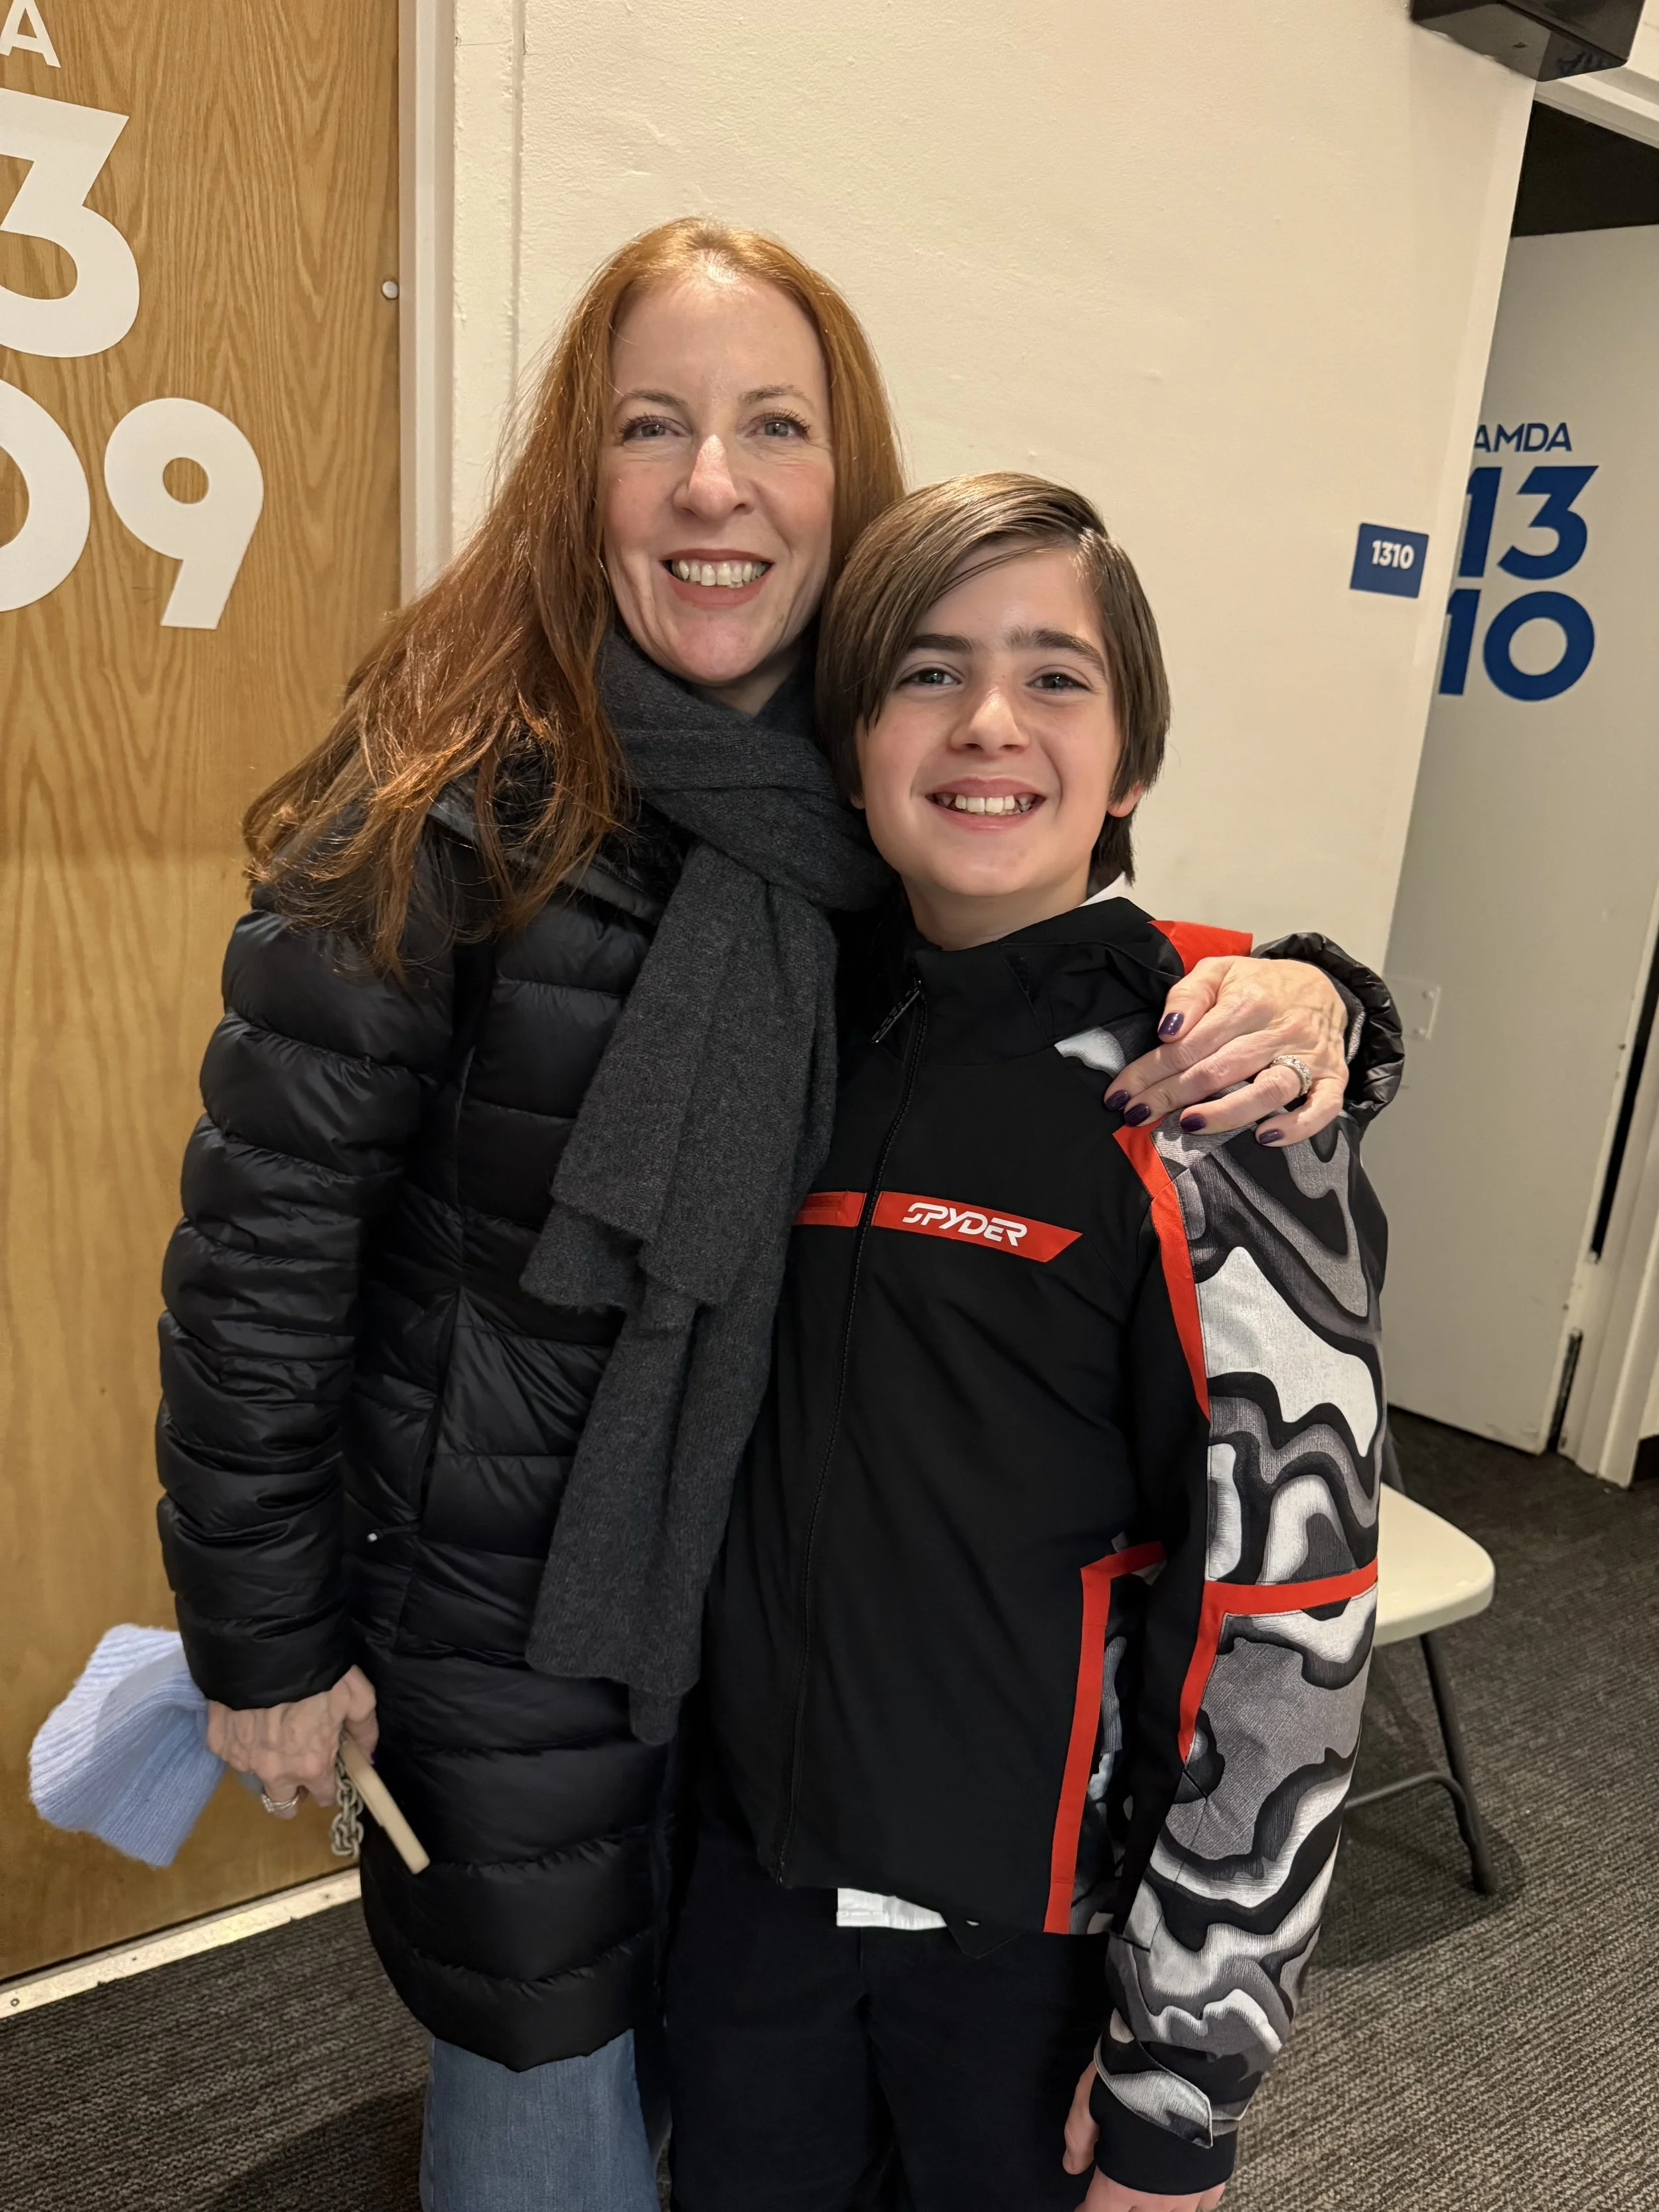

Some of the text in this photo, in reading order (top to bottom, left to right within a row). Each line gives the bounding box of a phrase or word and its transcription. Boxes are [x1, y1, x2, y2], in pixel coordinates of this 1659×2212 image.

[1473, 422, 1573, 453] AMDA
[1458, 465, 1599, 580] 13
[1372, 540, 1414, 569] 1310
[1438, 589, 1595, 702] 10
[902, 1202, 1028, 1246] SPYDER
